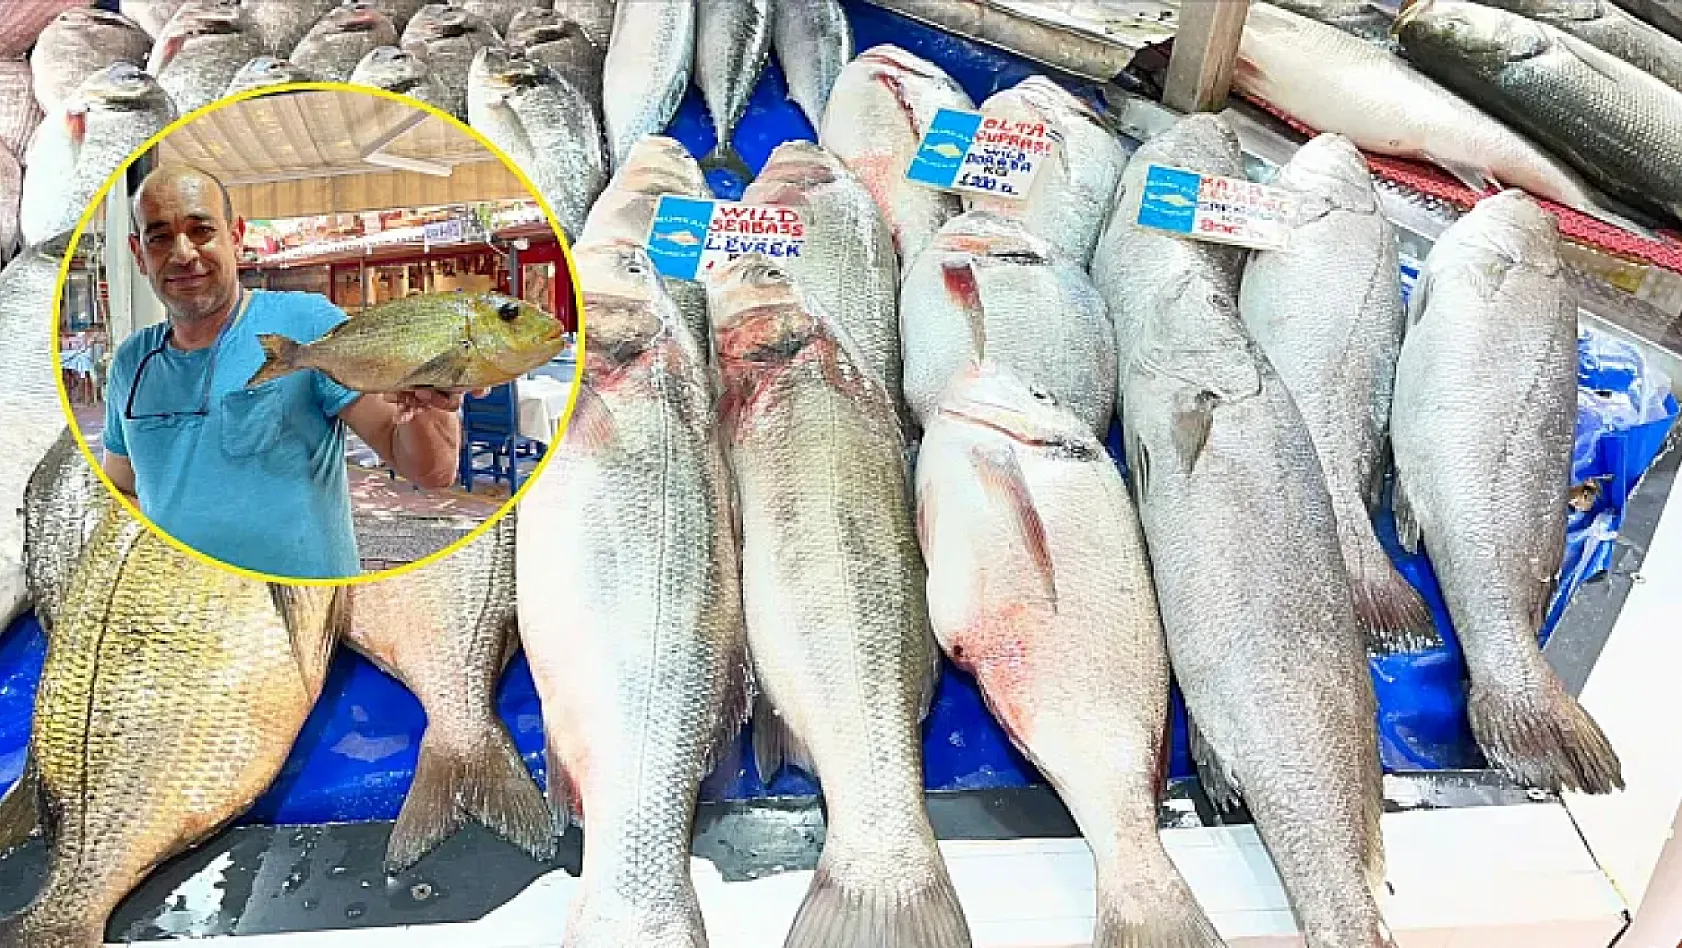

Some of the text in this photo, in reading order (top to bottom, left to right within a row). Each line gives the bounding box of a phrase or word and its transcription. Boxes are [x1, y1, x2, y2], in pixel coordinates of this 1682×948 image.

[720, 207, 800, 223] WILD
[707, 219, 805, 237] SEABASS
[704, 236, 802, 258] LEVREK
